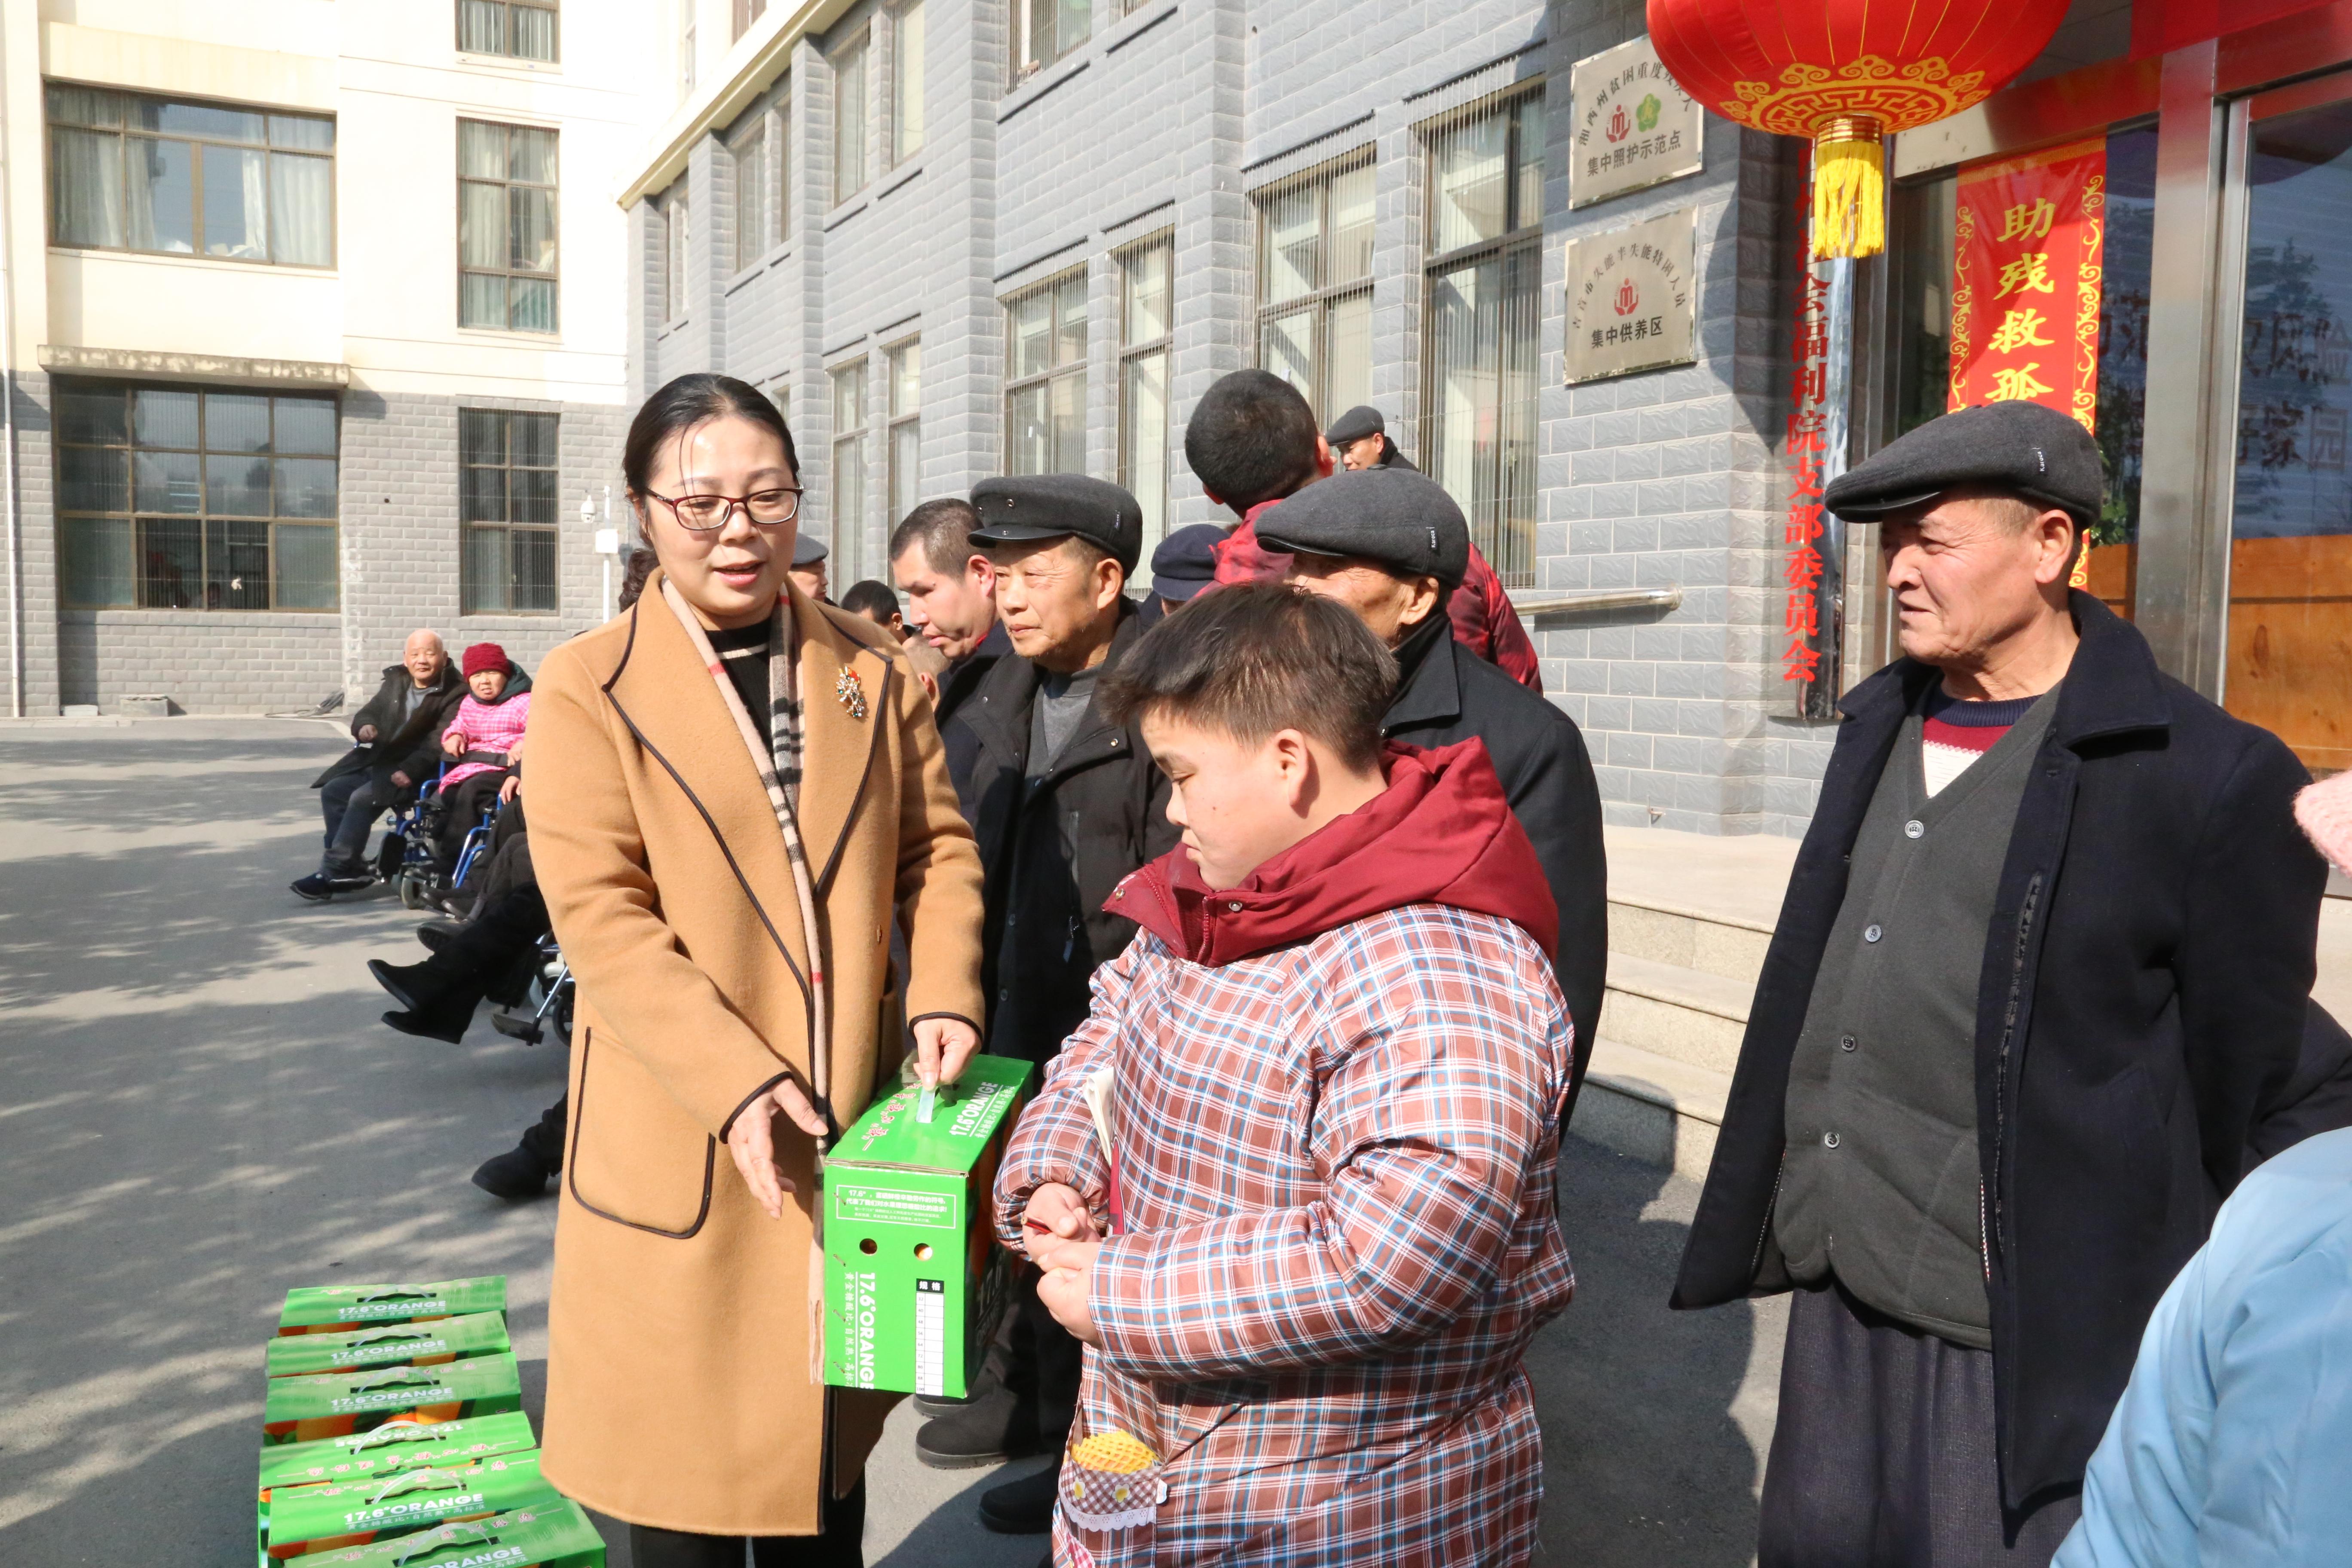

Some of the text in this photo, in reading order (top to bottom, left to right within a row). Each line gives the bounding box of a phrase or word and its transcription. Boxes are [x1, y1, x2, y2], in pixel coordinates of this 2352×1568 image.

[1587, 130, 1681, 177] 集中照护示范点
[1985, 198, 2056, 403] 助残救孤
[1592, 316, 1663, 349] 集中供养区
[919, 1280, 940, 1291] 规格
[344, 1493, 484, 1523] 17.6°ORANGE
